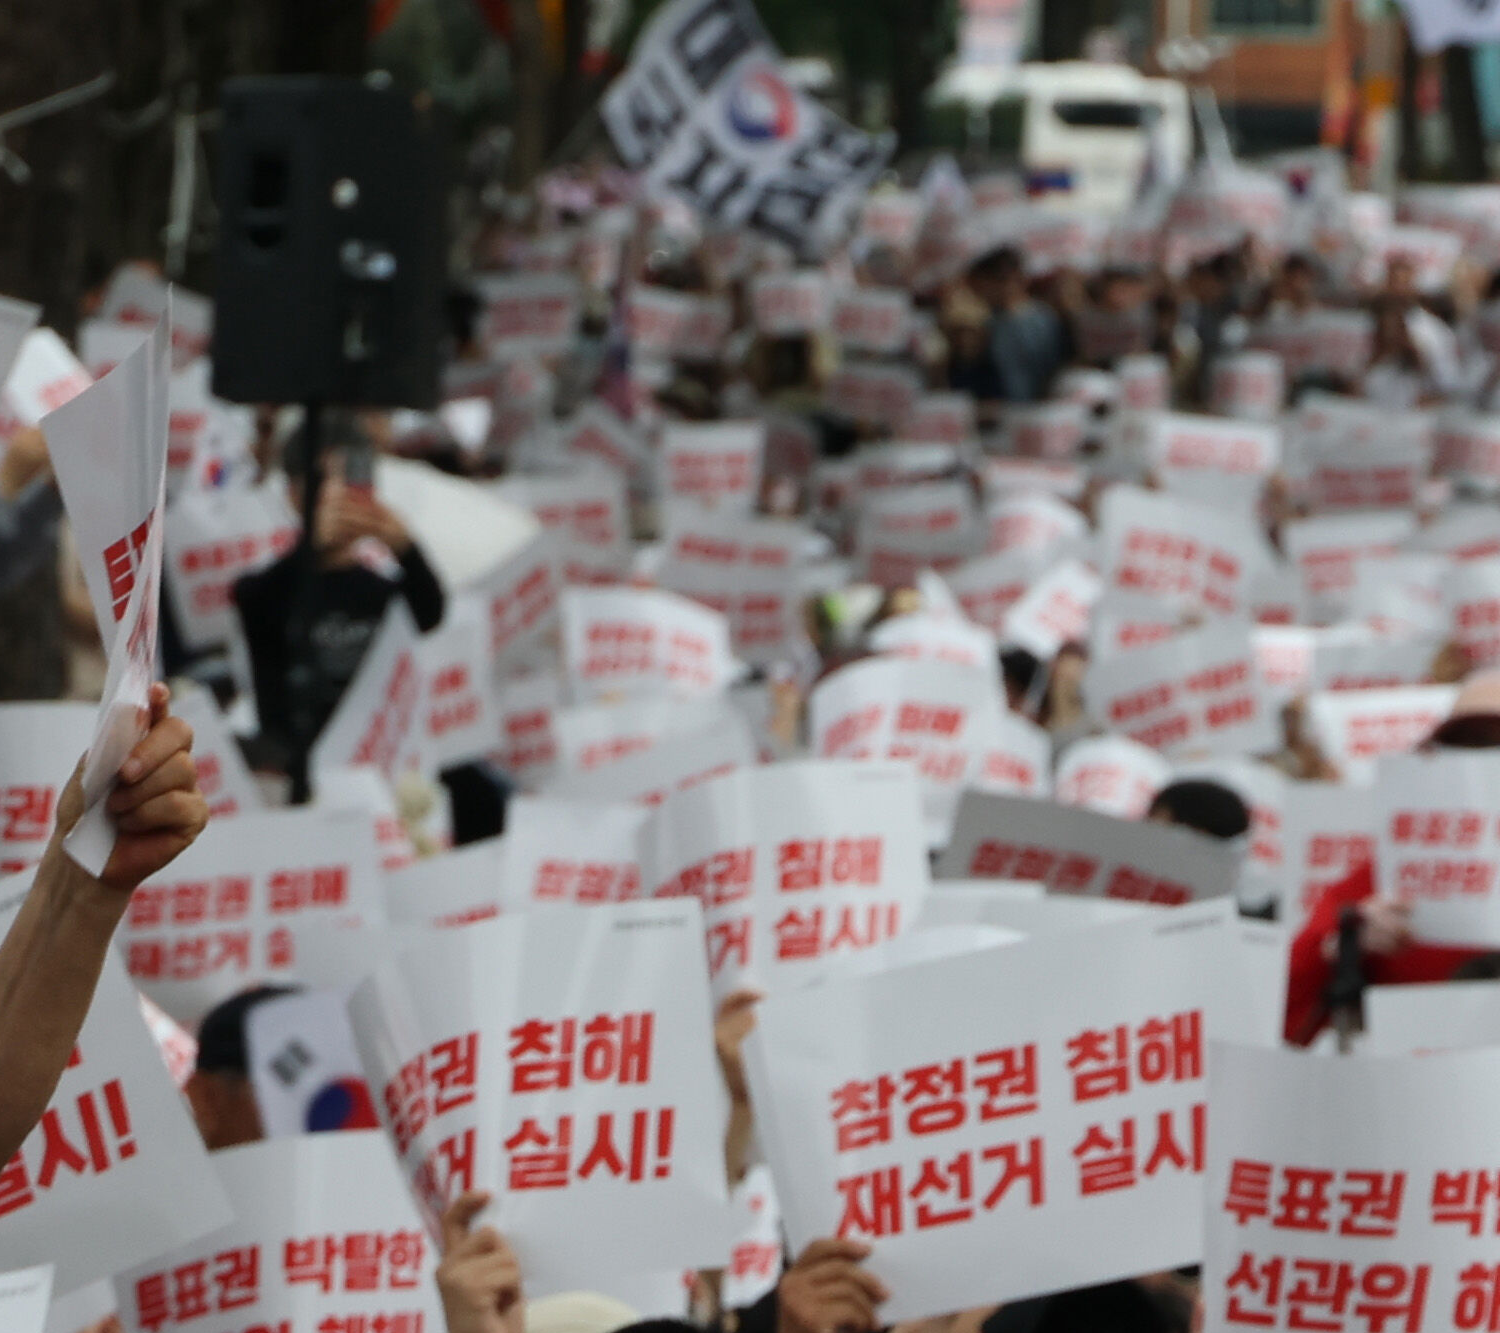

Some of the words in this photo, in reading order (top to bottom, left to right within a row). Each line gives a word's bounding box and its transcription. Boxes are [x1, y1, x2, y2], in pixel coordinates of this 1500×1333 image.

[129, 880, 249, 926] 참정권
[271, 869, 346, 911] 침해
[780, 841, 879, 891] 침해
[775, 907, 897, 960] 실시!
[510, 1014, 652, 1092] 침해
[833, 1044, 1042, 1149] 참정권
[1068, 1011, 1202, 1102] 침해
[505, 1109, 674, 1190] 실시!
[834, 1138, 1045, 1241] 재선거
[1073, 1105, 1205, 1195] 실시
[1225, 1160, 1405, 1237] 투표권
[137, 1246, 260, 1331] 투표권
[284, 1232, 423, 1292] 박탈한
